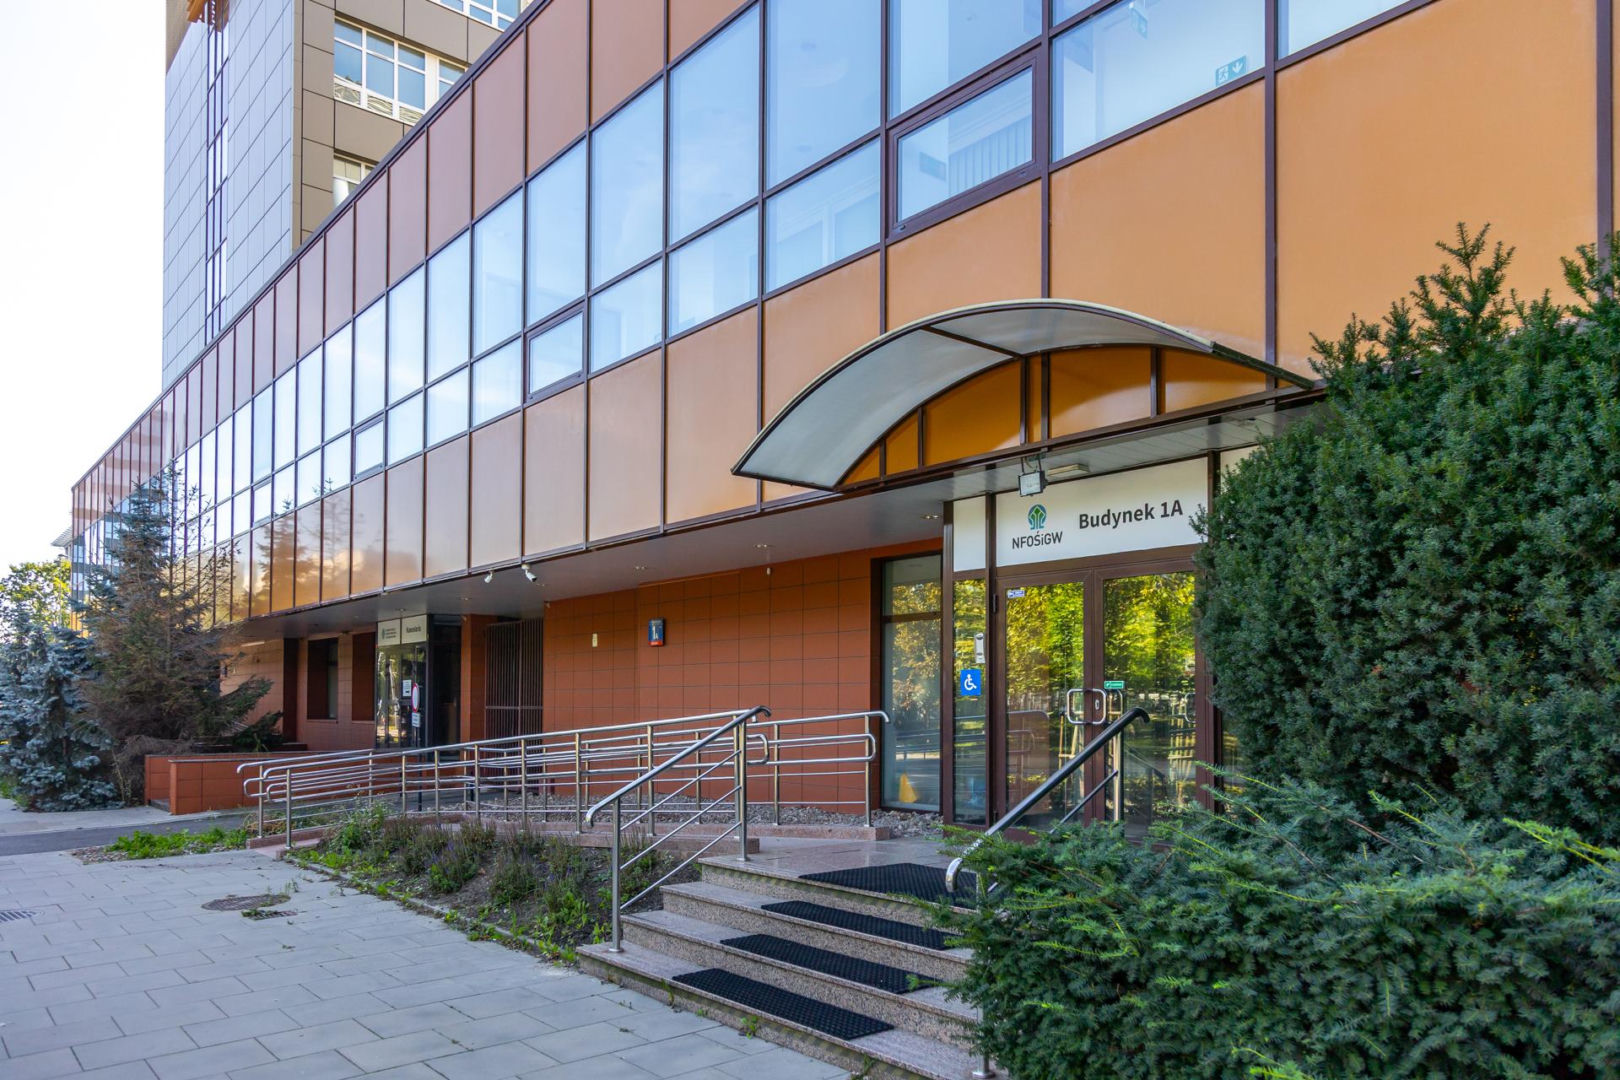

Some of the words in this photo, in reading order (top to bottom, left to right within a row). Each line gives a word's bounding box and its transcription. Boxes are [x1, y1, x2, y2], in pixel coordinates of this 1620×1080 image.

[1079, 503, 1155, 529] Budynek
[1160, 499, 1183, 518] 1A
[1012, 531, 1063, 549] NFOŚiGW
